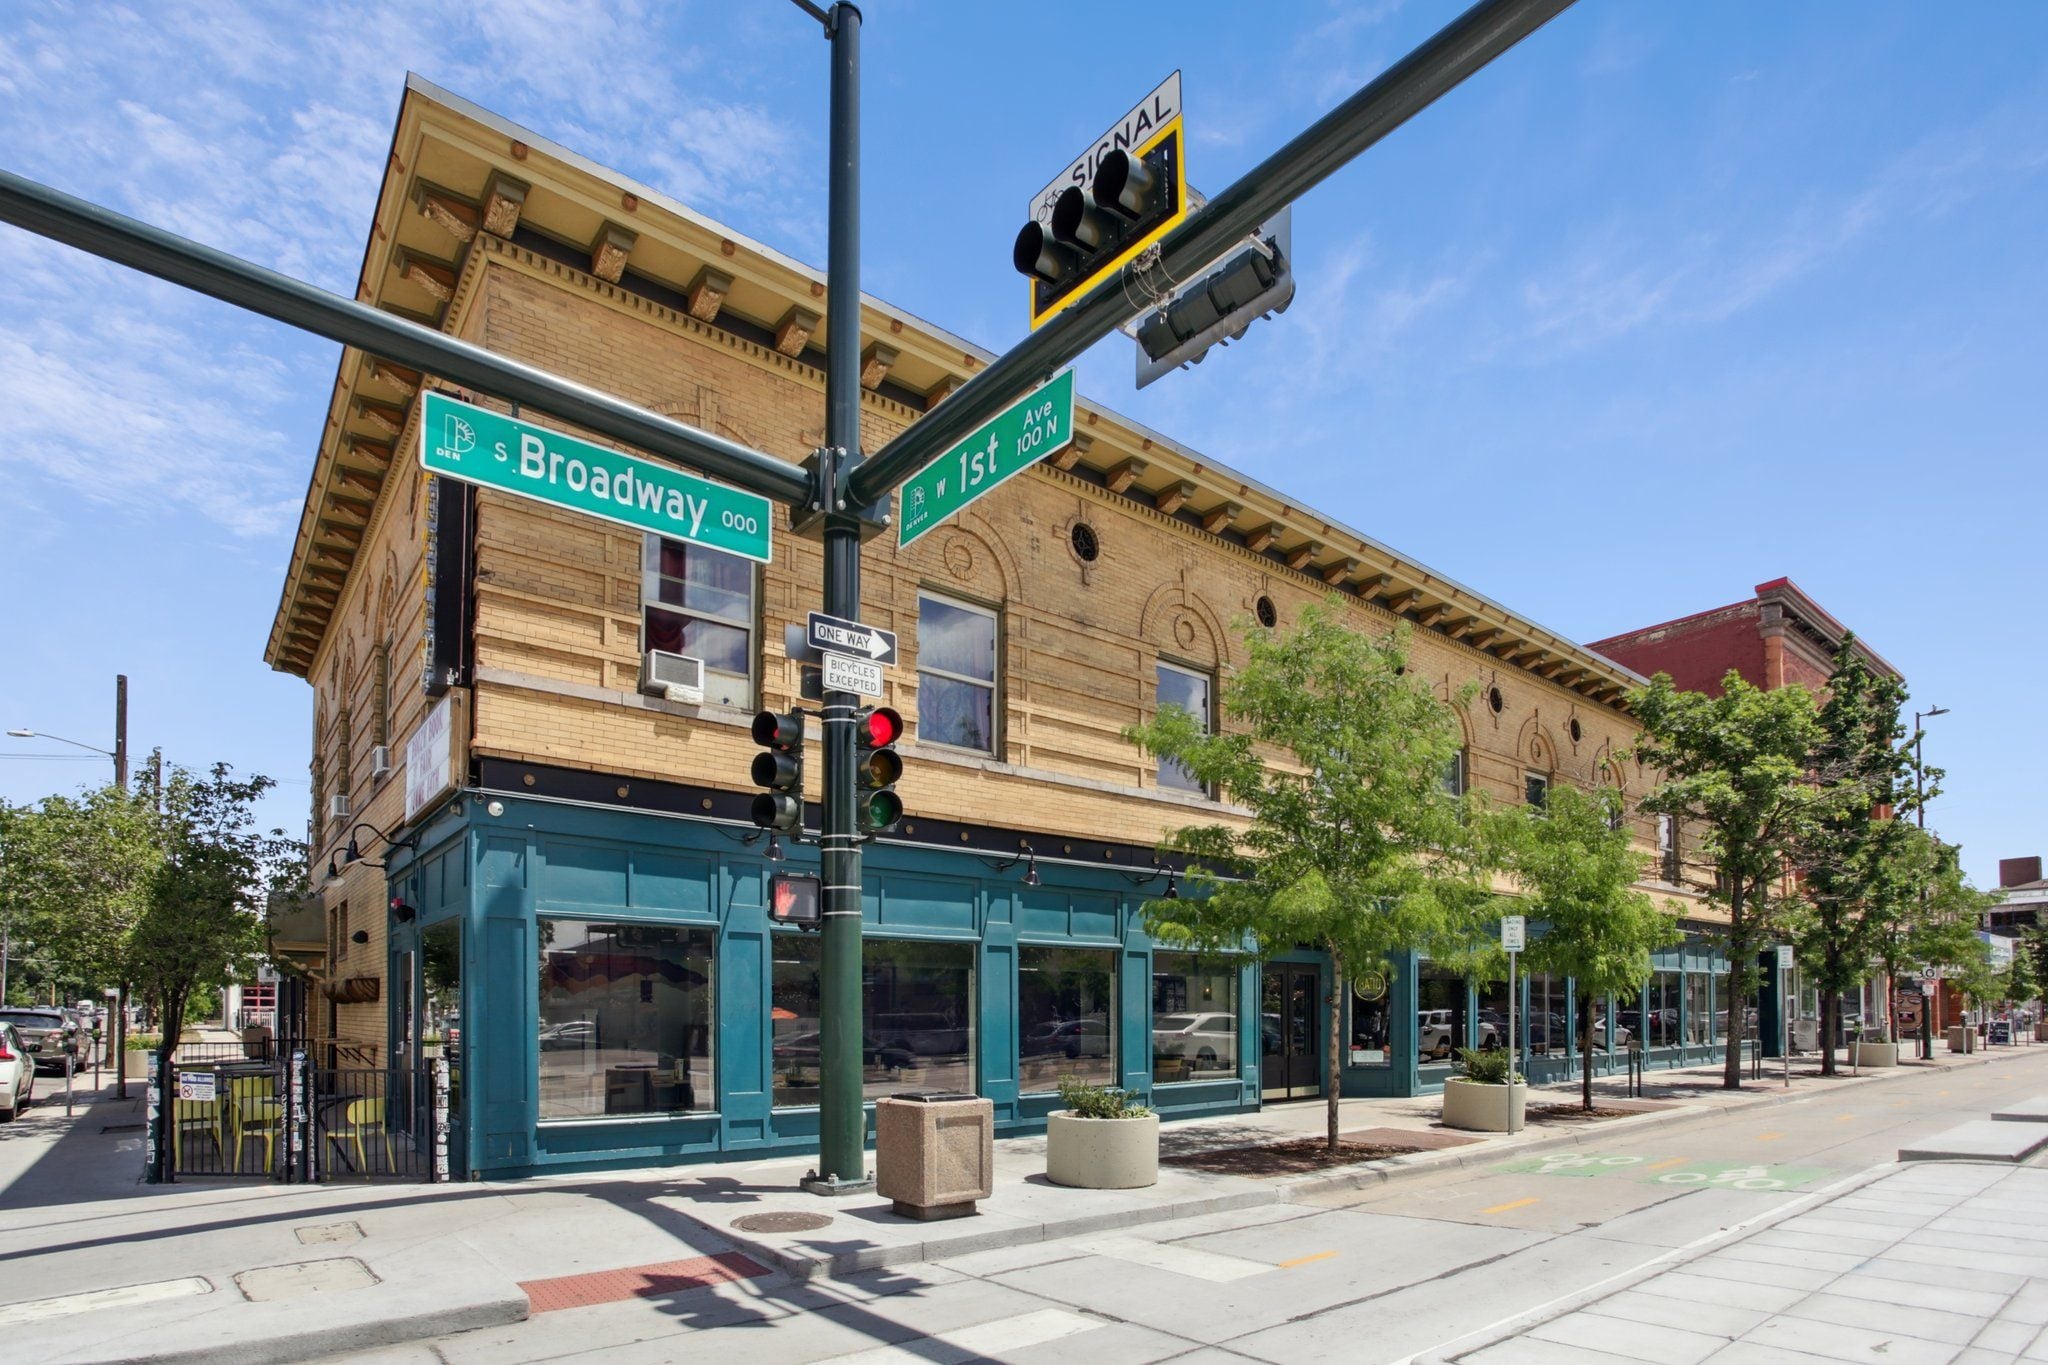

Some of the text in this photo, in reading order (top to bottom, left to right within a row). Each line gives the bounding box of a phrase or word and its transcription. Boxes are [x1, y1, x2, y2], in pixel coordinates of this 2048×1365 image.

[1023, 401, 1053, 431] Ave
[1017, 415, 1058, 456] 100 N
[436, 447, 461, 461] DEN
[936, 432, 999, 499] W 1st
[494, 441, 507, 462] S
[520, 433, 709, 538] Broadway
[906, 511, 928, 531] DENVER
[818, 625, 871, 649] ONE WAY
[831, 659, 876, 679] BICYCLES
[829, 672, 877, 692] EXCEPTED
